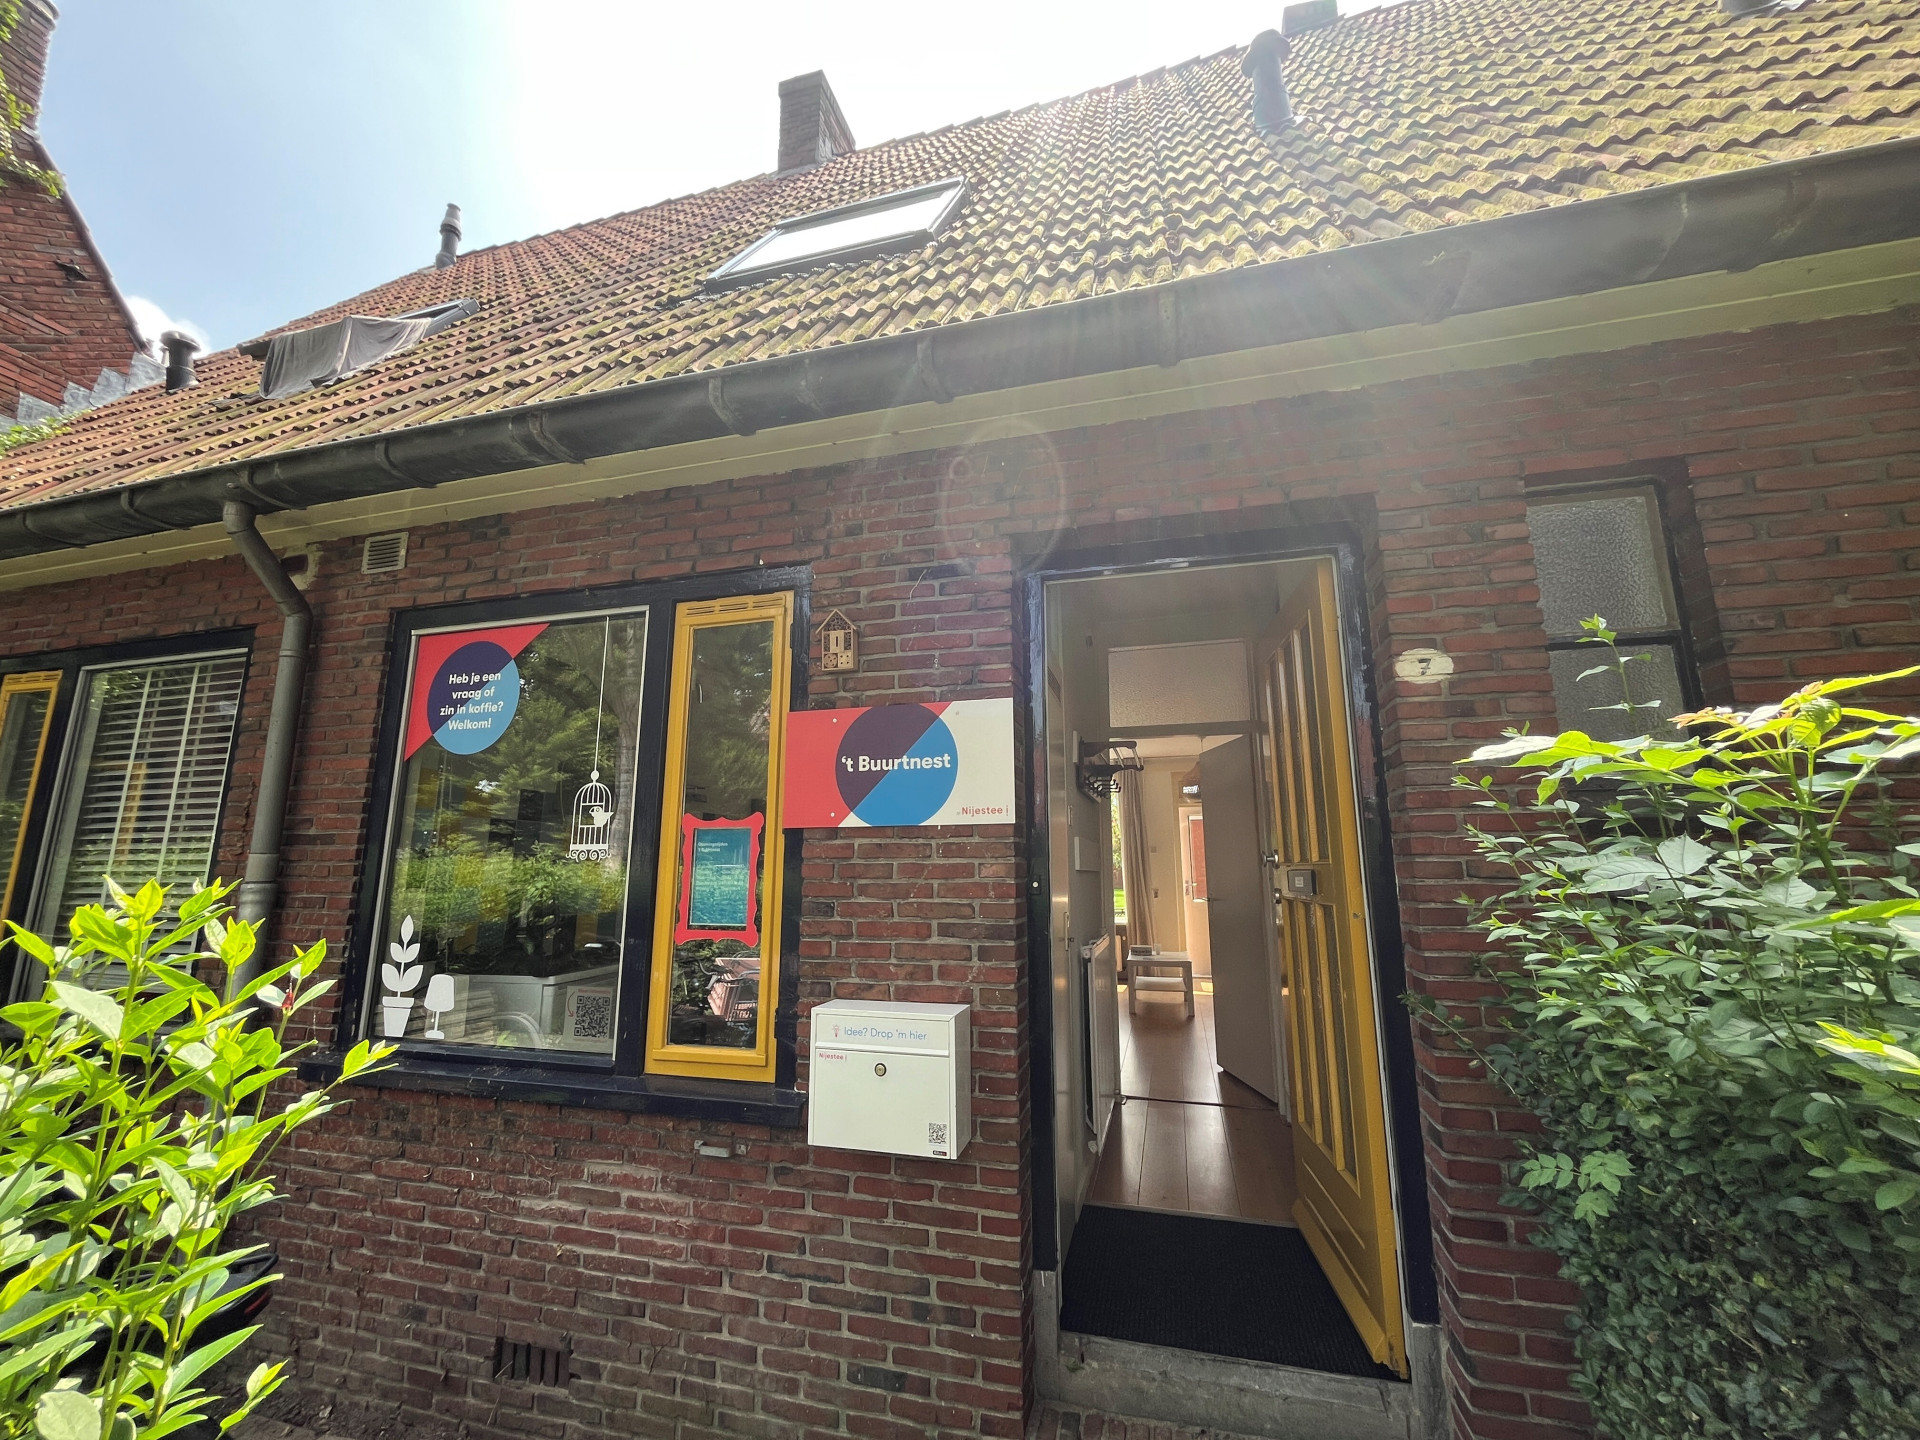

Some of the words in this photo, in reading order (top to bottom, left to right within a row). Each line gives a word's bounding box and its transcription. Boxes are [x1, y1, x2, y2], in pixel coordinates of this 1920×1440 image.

[1417, 657, 1432, 675] 7
[449, 673, 469, 684] Heb
[470, 672, 480, 685] je
[482, 672, 501, 681] een
[452, 689, 482, 700] vraag
[484, 686, 495, 697] of
[440, 705, 454, 716] zin
[456, 704, 466, 714] in
[468, 701, 504, 714] koffie?
[448, 718, 492, 731] Welkom!
[858, 753, 951, 772] Buurtnest
[961, 806, 1003, 817] Nijestee
[844, 1026, 868, 1037] Idee?
[870, 1028, 894, 1041] Drop
[909, 1030, 928, 1040] hier
[818, 1052, 844, 1061] Nijestee
